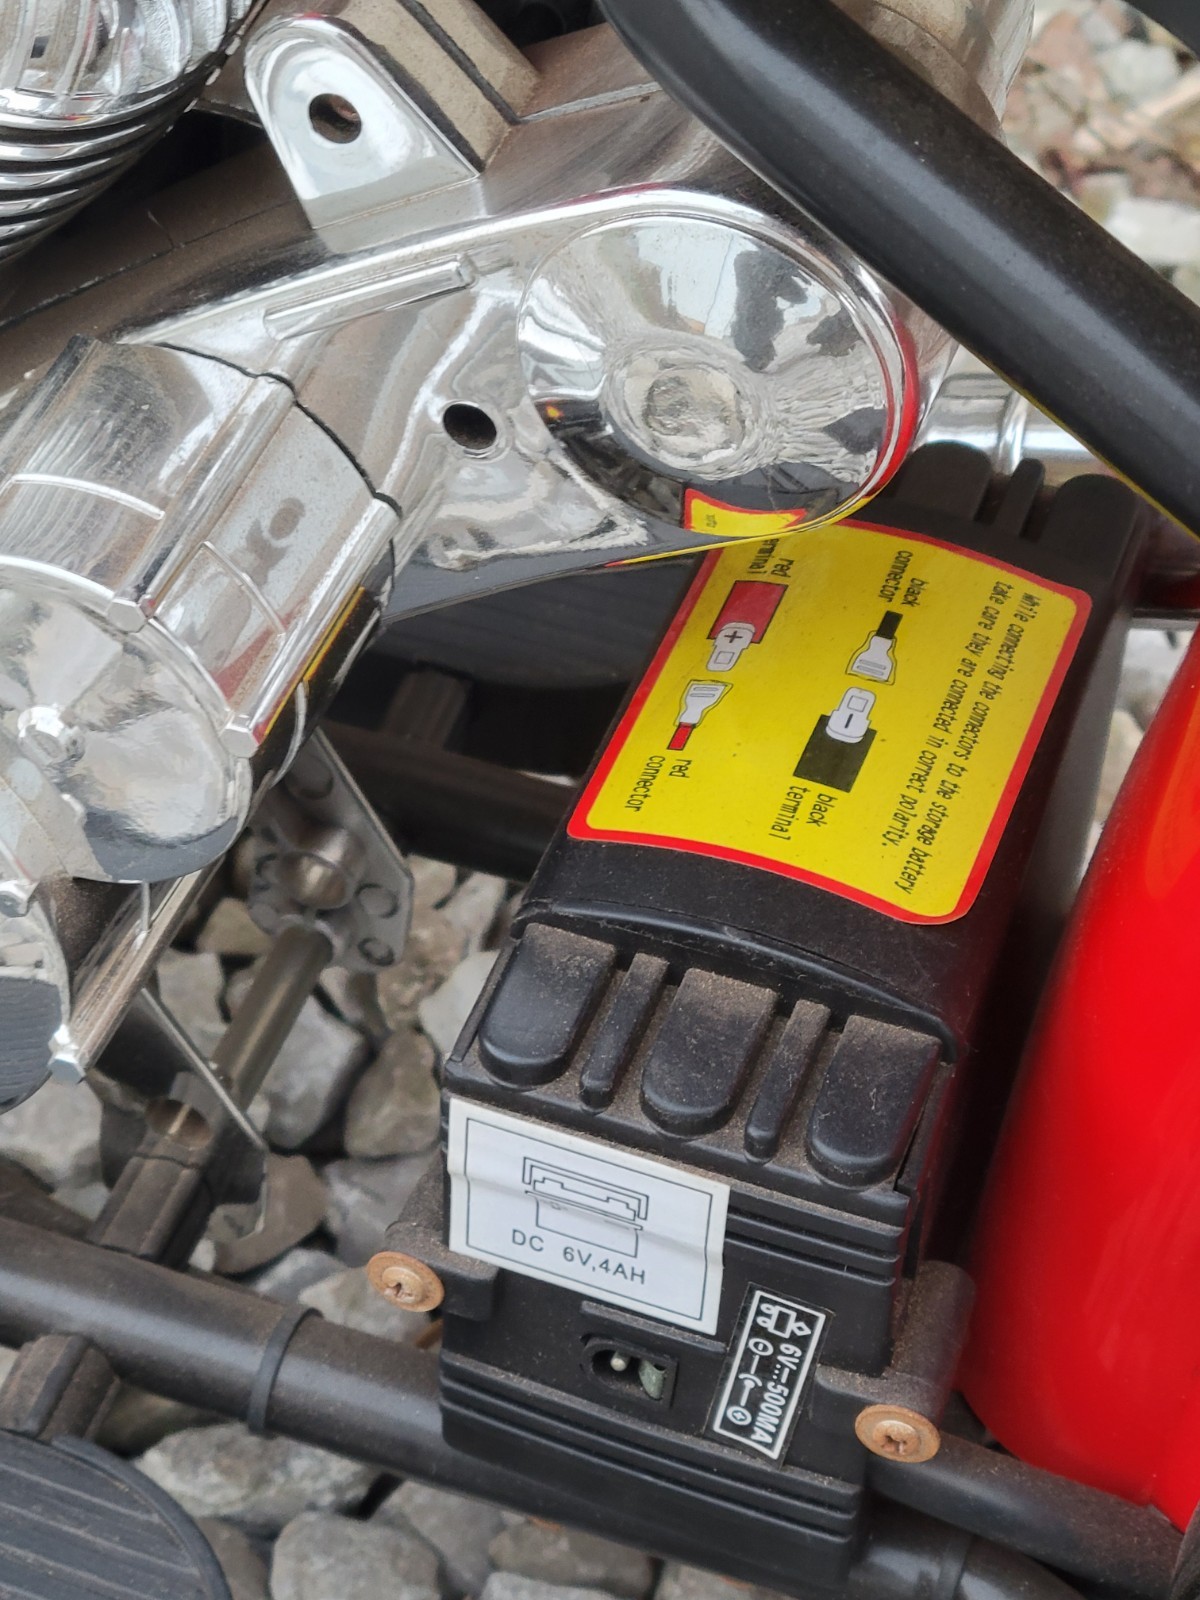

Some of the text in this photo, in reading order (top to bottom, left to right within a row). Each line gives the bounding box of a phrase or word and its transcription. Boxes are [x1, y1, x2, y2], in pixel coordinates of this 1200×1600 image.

[747, 538, 780, 574] erminal
[771, 558, 795, 578] red
[878, 550, 914, 603] connector
[902, 578, 928, 607] black
[881, 581, 1014, 846] take care they are connected in correct polarity.
[894, 592, 1041, 895] While connecting the connectors to the storage battery
[625, 755, 666, 812] connector
[669, 758, 692, 778] red
[768, 785, 811, 840] terminal
[806, 793, 838, 827] black
[511, 1229, 545, 1252] DC
